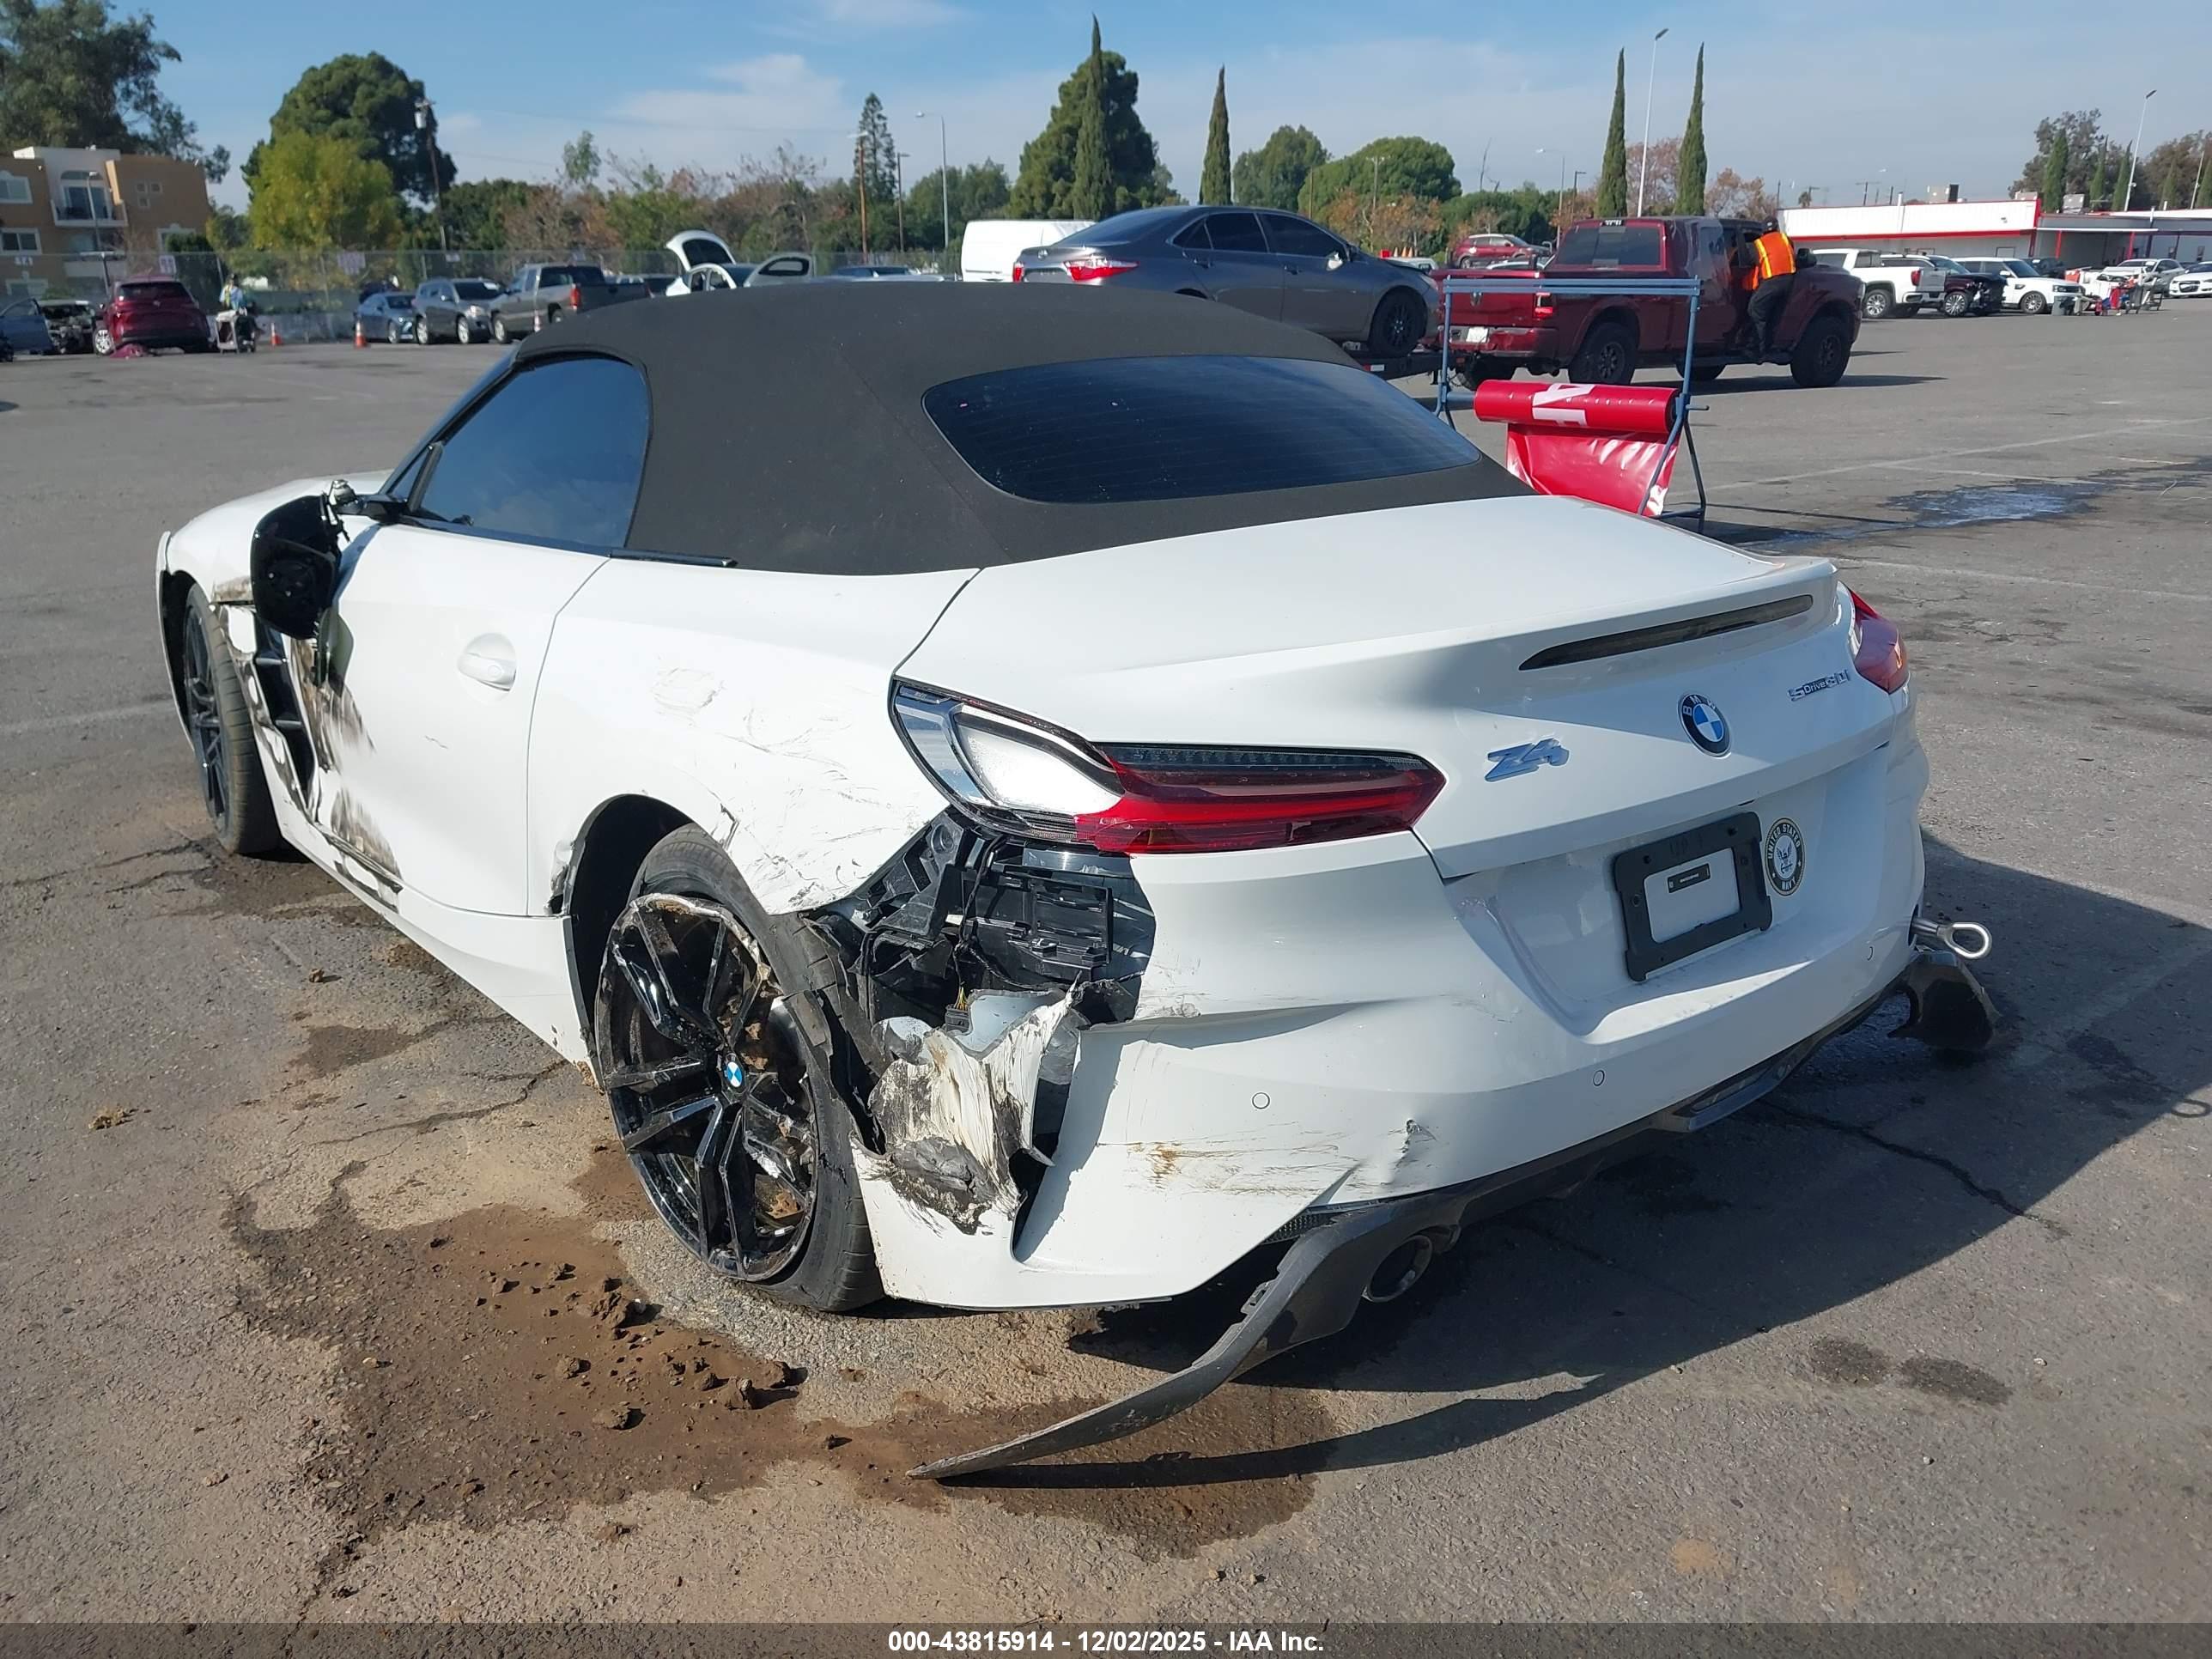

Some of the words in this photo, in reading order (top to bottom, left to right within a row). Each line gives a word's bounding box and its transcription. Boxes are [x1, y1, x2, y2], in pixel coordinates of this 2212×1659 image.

[1682, 695, 1717, 716] BMW
[1485, 738, 1570, 782] Z4
[1767, 826, 1782, 860] UNITED
[1782, 824, 1802, 848] STATES
[1781, 877, 1796, 890] NAVY
